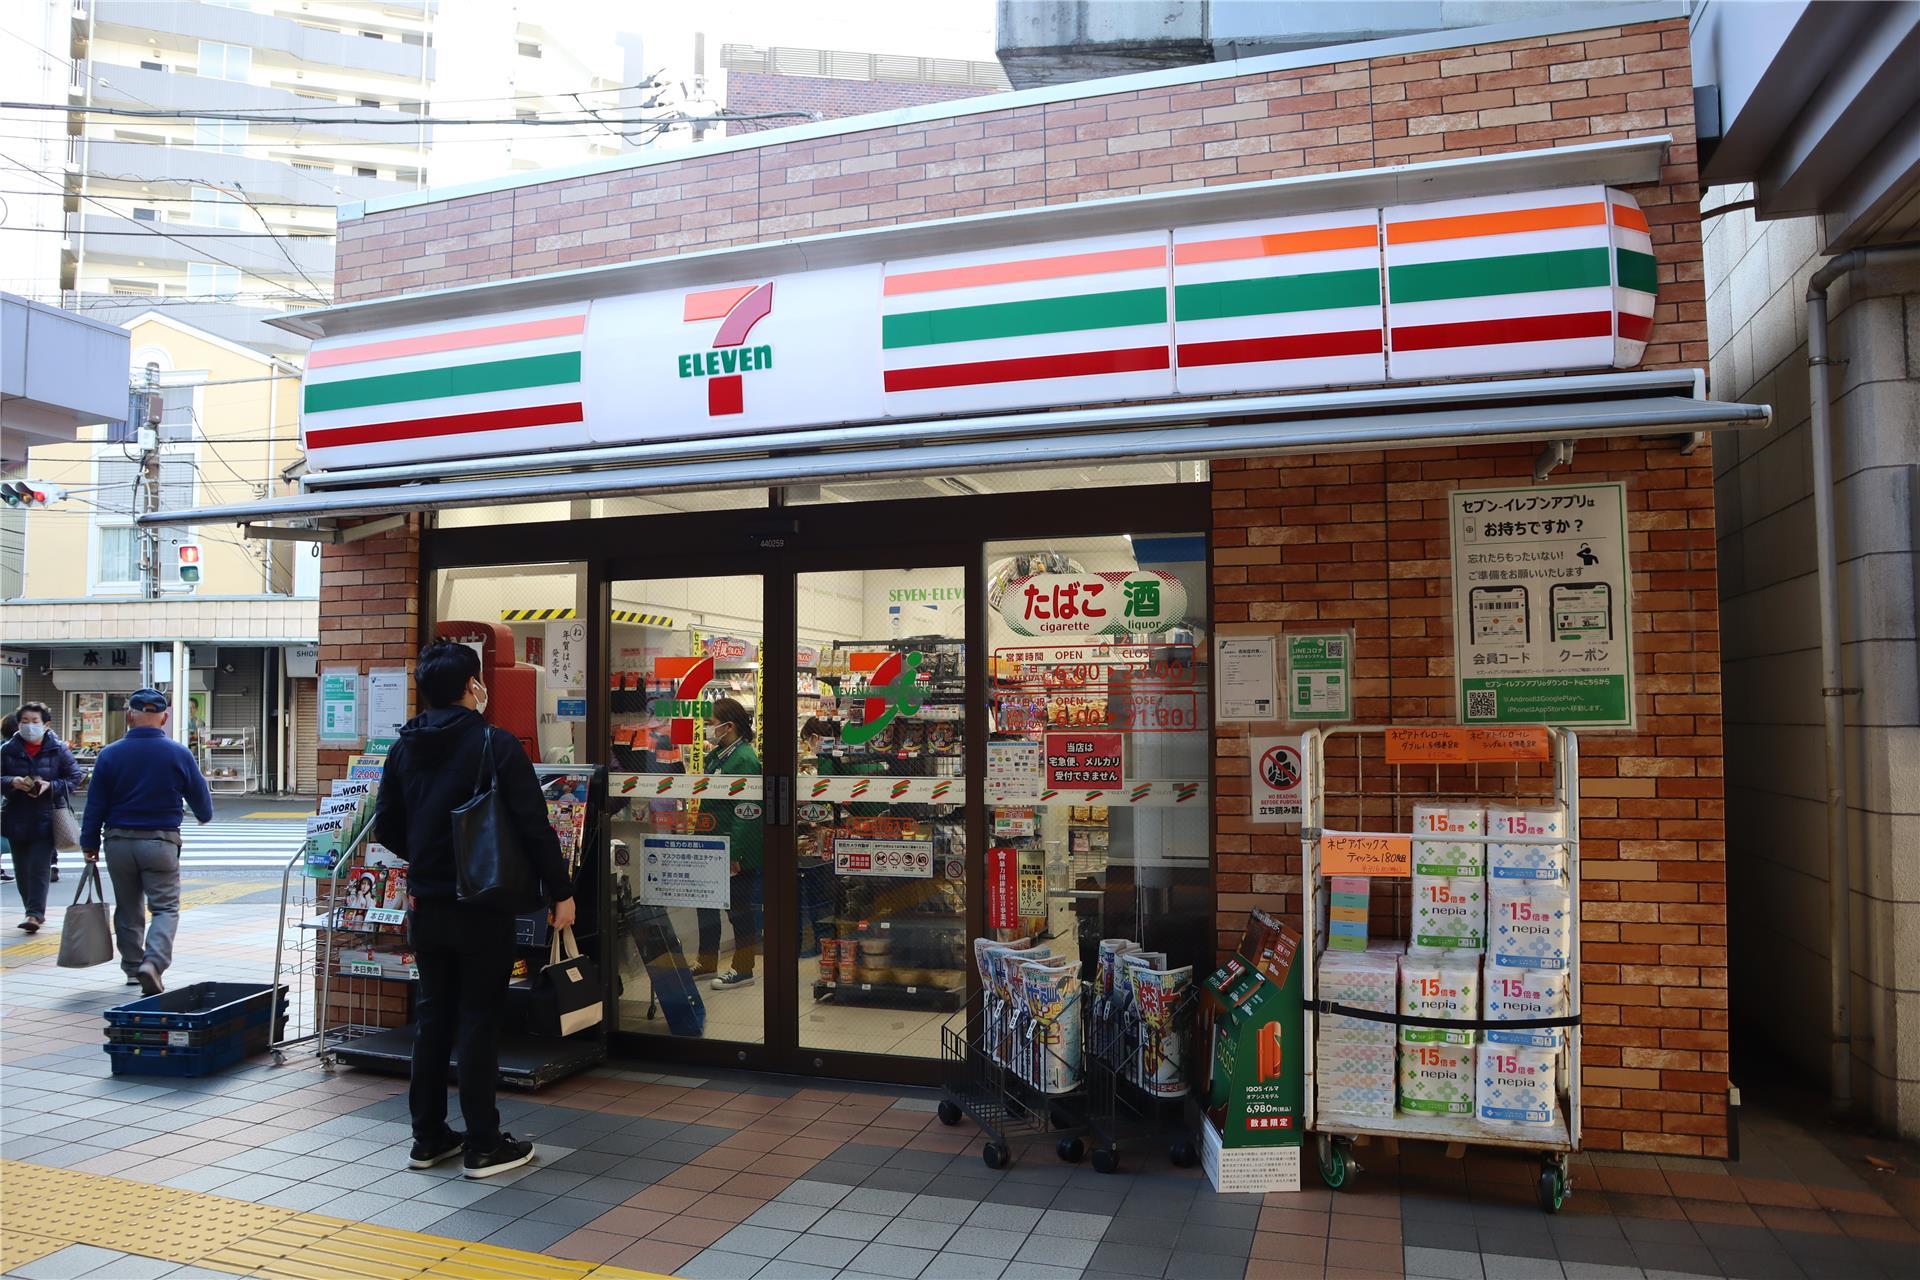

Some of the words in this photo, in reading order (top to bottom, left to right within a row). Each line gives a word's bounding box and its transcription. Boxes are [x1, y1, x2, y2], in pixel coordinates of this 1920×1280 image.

[1462, 494, 1595, 514] セブン-イレブンアプリは
[1484, 519, 1584, 537] お持ちですか？
[760, 538, 784, 547] 440259
[1468, 566, 1584, 581] ご準備をお願いいたします
[889, 588, 965, 602] SEVEN-ELEV
[1024, 581, 1107, 620] たばこ
[1124, 580, 1160, 617] 酒
[1040, 621, 1090, 632] cigarette
[1128, 620, 1162, 631] liquor
[562, 629, 571, 683] 年賀はがき
[1006, 652, 1044, 662] 営業時間
[1055, 650, 1083, 660] OPEN
[1122, 649, 1155, 659] CLOSE
[1473, 651, 1531, 666] 会員コード
[1559, 648, 1609, 663] クーポン
[1055, 662, 1100, 681] 6:00
[1122, 662, 1183, 681] 23:00
[1005, 674, 1044, 682] WEEKDAY
[1055, 696, 1084, 706] OPEN
[1122, 695, 1156, 706] CLOSE
[1055, 709, 1100, 727] 6:00
[1122, 708, 1183, 727] 21:30
[1392, 730, 1451, 740] ネピアトイレロール
[1470, 731, 1529, 740] ネピアトイレロール
[1067, 742, 1094, 753] 当店は
[1049, 756, 1121, 768] 宅急便、メルカリ
[1055, 771, 1118, 782] 受付できません
[342, 783, 369, 796] WORK
[331, 802, 357, 814] WORK
[1259, 806, 1302, 815] 立ち読み禁
[316, 820, 342, 832] WORK
[1327, 838, 1389, 851] ネピアボックス
[1432, 906, 1467, 916] nepia
[370, 912, 400, 923] 本日発売
[1512, 925, 1550, 935] nepia
[354, 965, 380, 975] 本日発売
[1421, 1000, 1457, 1010] nepia
[1503, 1002, 1541, 1012] nepia
[1421, 1070, 1457, 1079] nepia
[1498, 1078, 1536, 1088] nepia
[1246, 1104, 1292, 1114] 6,980円(税込)
[1250, 1118, 1288, 1127] 数量限定
